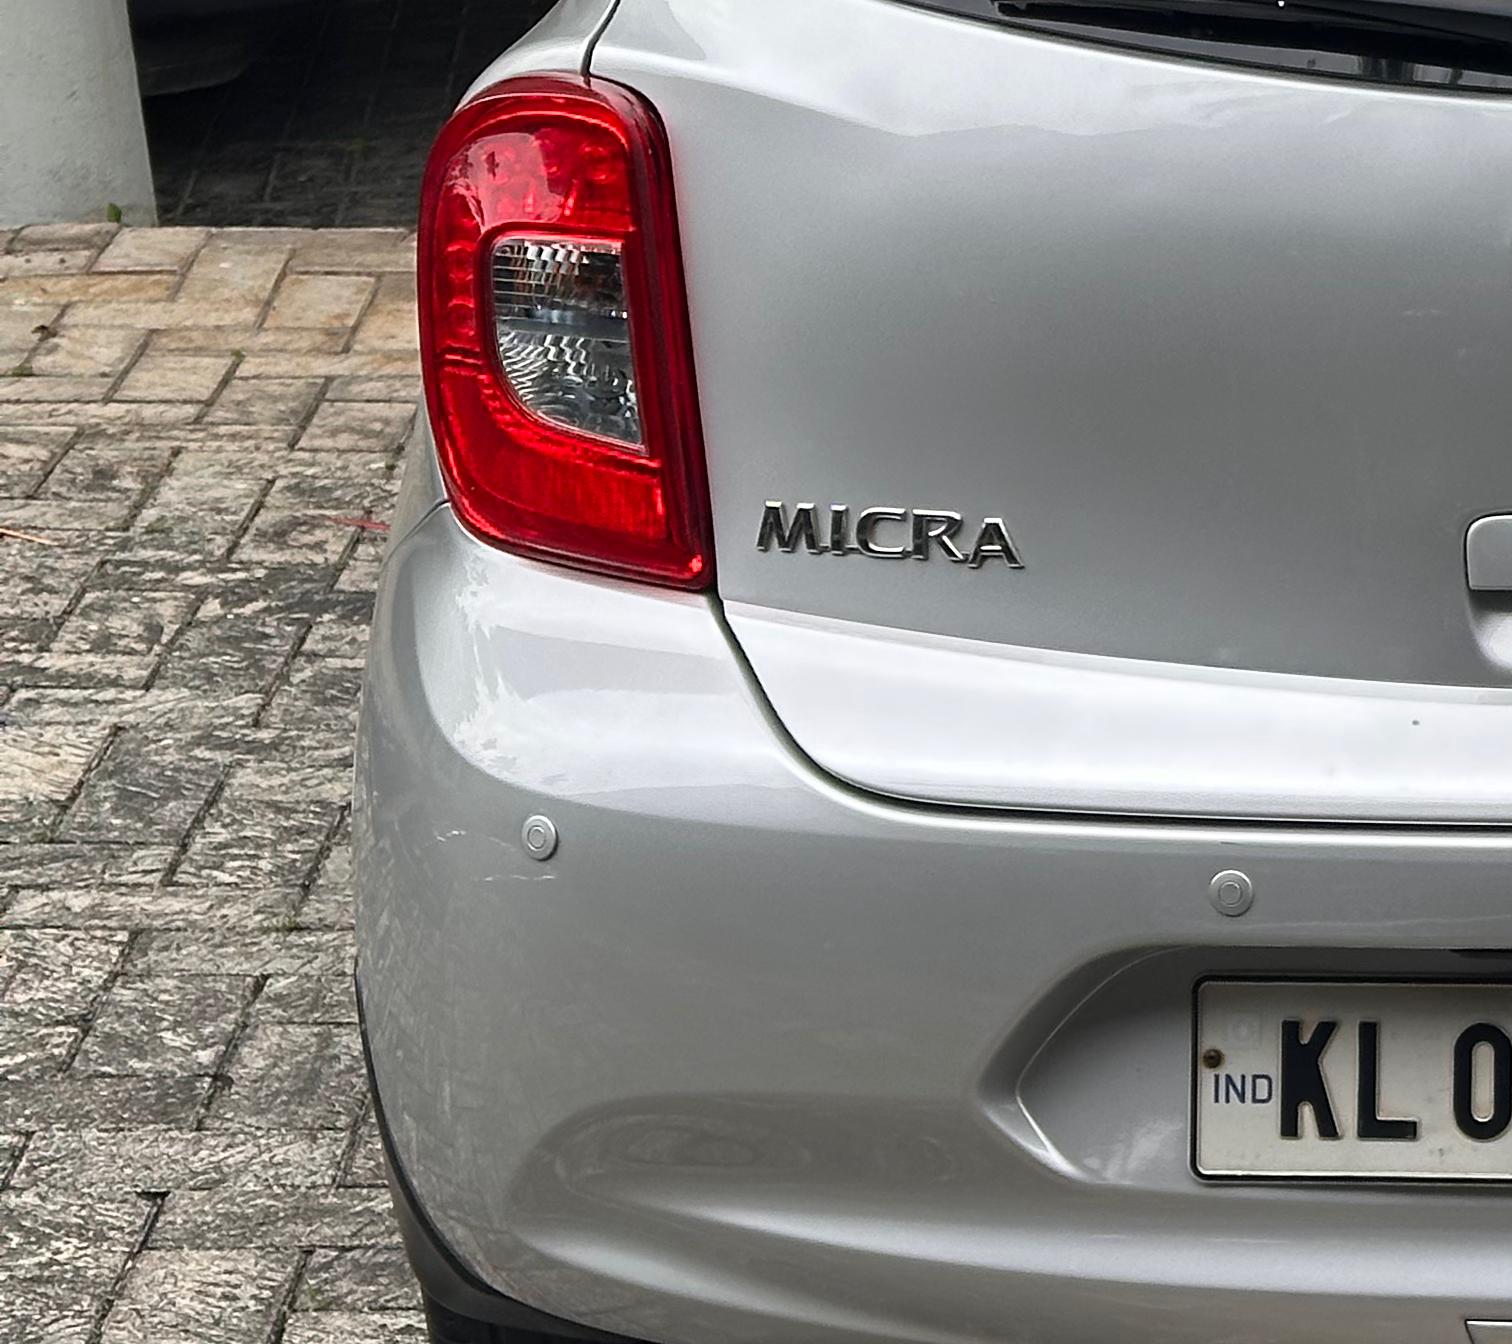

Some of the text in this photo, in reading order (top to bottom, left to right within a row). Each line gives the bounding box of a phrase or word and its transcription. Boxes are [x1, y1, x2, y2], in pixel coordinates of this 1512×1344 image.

[756, 499, 1026, 569] MICRA
[1213, 1073, 1273, 1105] IND
[1280, 1019, 1418, 1140] KL
